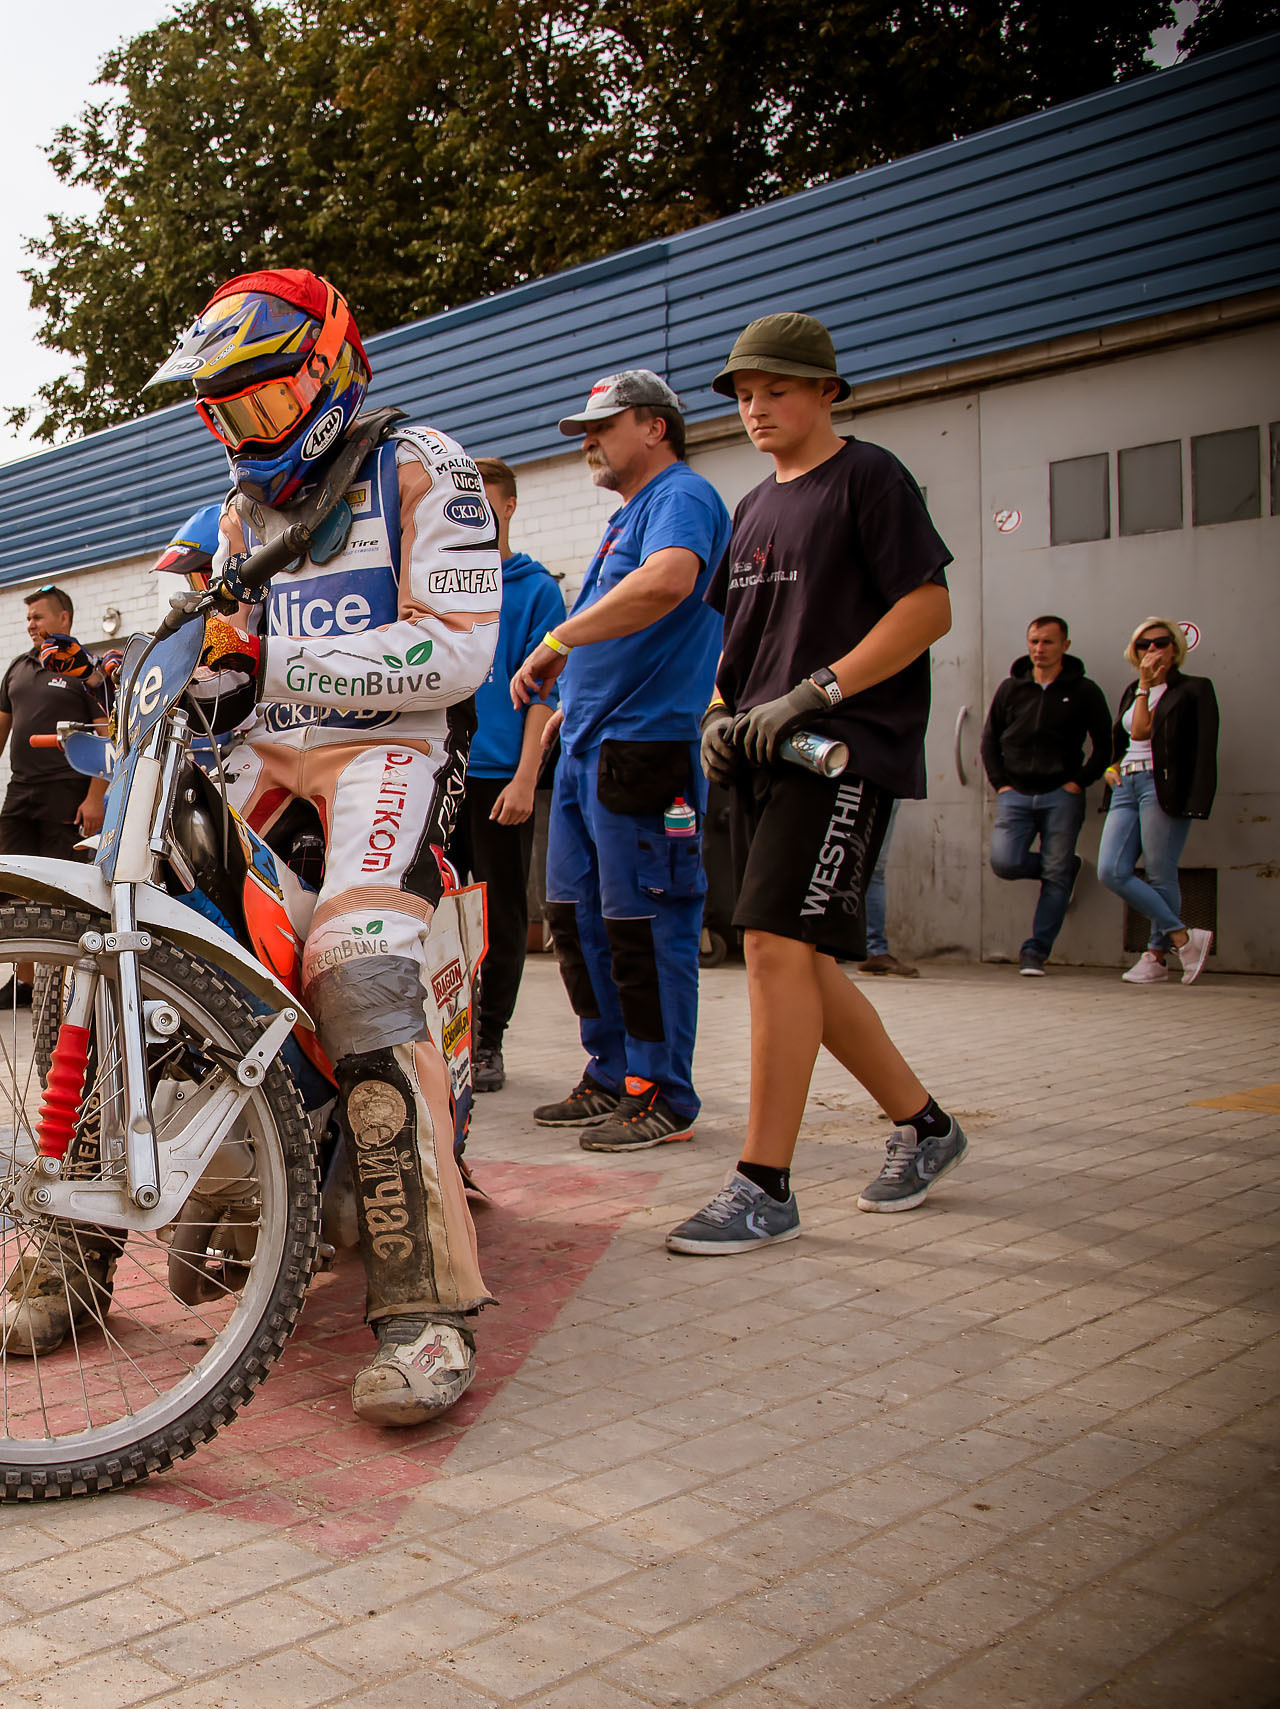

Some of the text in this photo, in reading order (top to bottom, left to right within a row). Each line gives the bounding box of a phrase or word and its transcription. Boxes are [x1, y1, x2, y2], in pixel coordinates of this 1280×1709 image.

[306, 411, 338, 458] Arai
[453, 472, 480, 491] Nice
[350, 539, 379, 549] Tire
[428, 568, 499, 594] CALIFA
[268, 590, 371, 637] Nice
[286, 663, 442, 697] GreenBūve
[433, 964, 463, 1002] DRAGON
